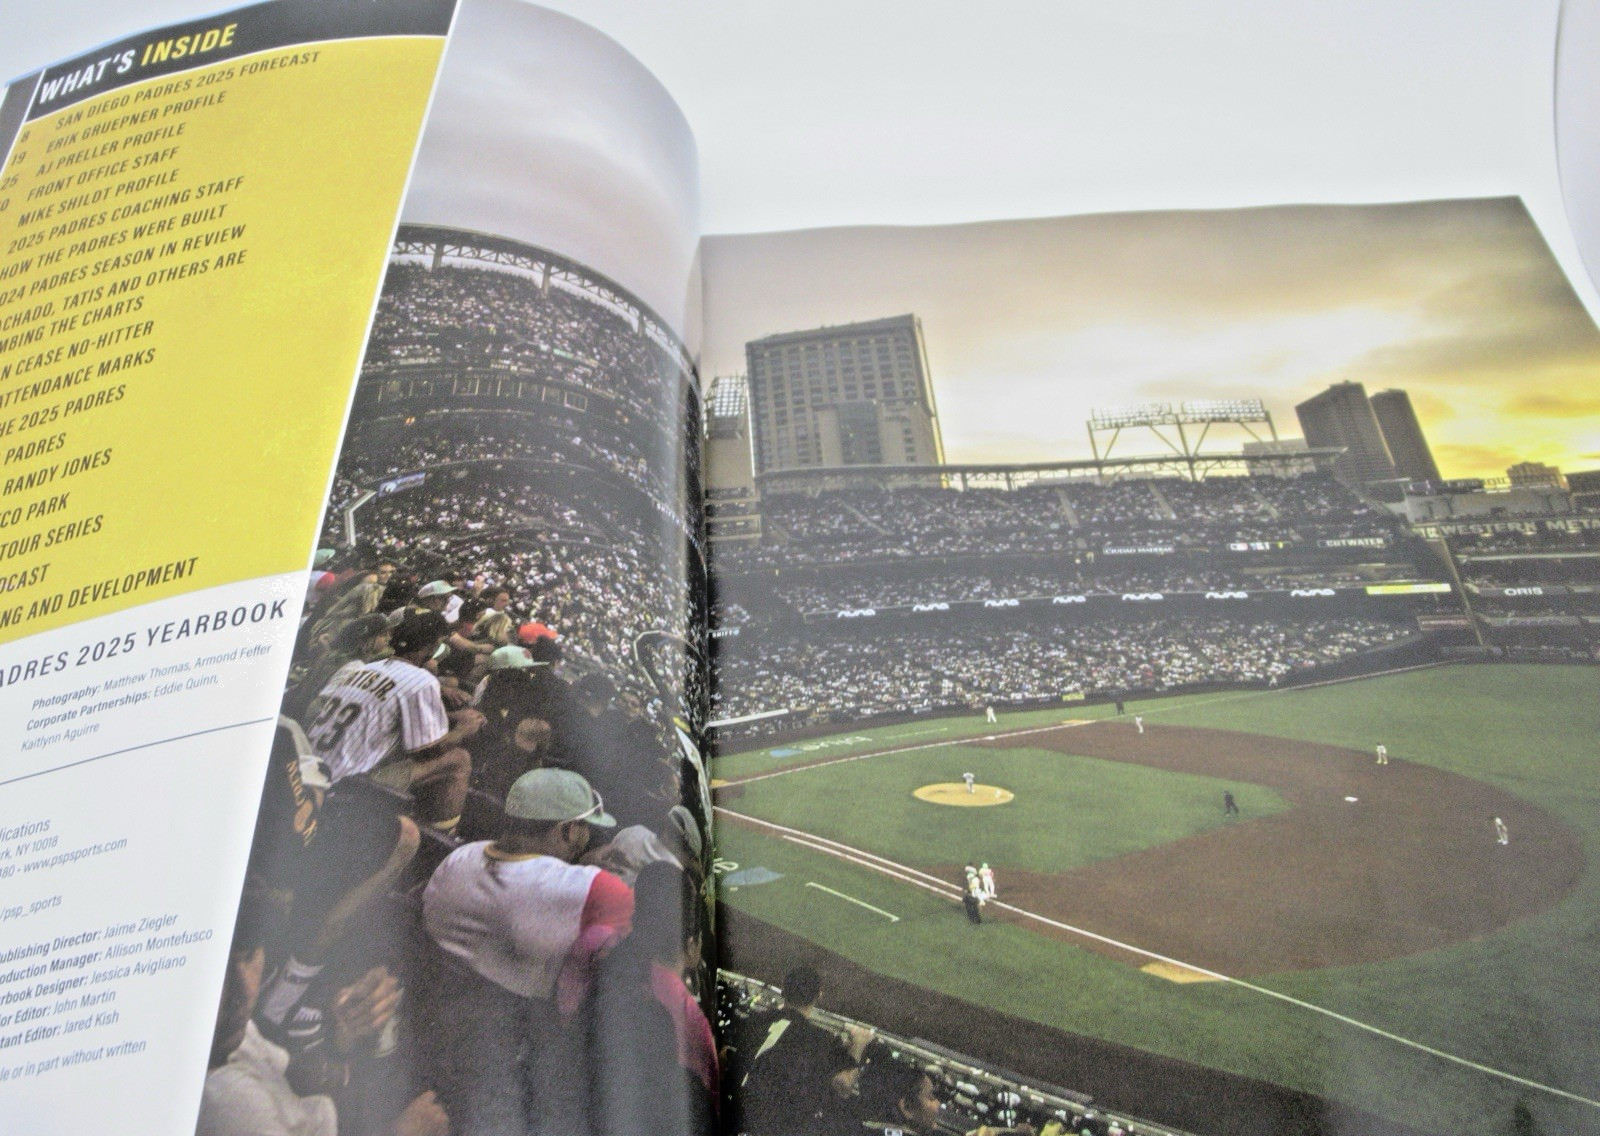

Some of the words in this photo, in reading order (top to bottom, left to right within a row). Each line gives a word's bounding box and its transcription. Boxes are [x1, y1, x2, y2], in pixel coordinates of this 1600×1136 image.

[39, 50, 136, 104] WHAT'S
[141, 23, 238, 67] INSIDE
[56, 110, 84, 130] SAN
[87, 95, 130, 118] DIEGO
[134, 79, 192, 104] PADRES
[196, 70, 235, 88] 2025
[239, 51, 321, 77] FORECAST
[11, 151, 27, 166] 19
[46, 132, 79, 154] ERIK
[81, 108, 159, 140] GRUEPNER
[163, 91, 228, 117] PROFILE
[0, 173, 20, 191] 25
[56, 140, 119, 170] PRELLER
[122, 122, 187, 150] PROFILE
[27, 175, 74, 201] FRONT
[77, 159, 129, 185] OFFICE
[132, 146, 180, 170] STAFF
[7, 230, 45, 255] 2025
[48, 211, 107, 241] PADRES
[111, 189, 191, 221] COACHING
[195, 175, 245, 199] STAFF
[17, 204, 55, 228] MIKE
[115, 168, 180, 198] PROFILE
[0, 258, 34, 280] HOW
[37, 248, 65, 268] THE
[68, 229, 128, 259] PADRES
[132, 216, 177, 240] WERE
[180, 204, 228, 228] BUILT
[30, 265, 88, 296] PADRES
[91, 247, 155, 276] SEASON
[159, 241, 178, 258] IN
[182, 224, 247, 252] REVIEW
[62, 286, 104, 311] TATIS
[107, 276, 141, 297] AND
[146, 259, 210, 287] OTHERS
[213, 249, 248, 271] ARE
[50, 315, 79, 337] THE
[82, 296, 145, 327] CHARTS
[15, 347, 65, 376] CEASE
[67, 320, 155, 359] NO-HITTER
[97, 348, 156, 378] MARKS
[18, 405, 60, 432] 2025
[63, 384, 127, 417] PADRES
[3, 465, 59, 496] RANDY
[61, 448, 113, 478] JONES
[4, 432, 67, 466] PADRES
[26, 492, 70, 521] PARK
[0, 533, 42, 562] TOUR
[44, 514, 104, 547] SERIES
[27, 594, 63, 620] AND
[67, 557, 198, 609] DEVELOPMENT
[76, 632, 137, 667] 2025
[147, 599, 288, 647] YEARBOOK
[32, 684, 102, 711] Photography:
[104, 671, 147, 691] Matthew
[149, 661, 192, 680] Thomas,
[194, 652, 237, 669] Armond
[240, 644, 272, 659] Feffer
[26, 710, 78, 731] Corporate
[79, 690, 151, 718] Partnerships:
[154, 681, 184, 698] Eddie
[185, 673, 219, 690] Quinn,
[21, 732, 62, 751] Kaitlynn
[63, 722, 100, 742] Aguirre
[16, 843, 31, 857] NY
[33, 835, 59, 853] 10018
[23, 838, 128, 873] www.pspsports.com
[50, 951, 103, 973] Manager:
[104, 942, 143, 960] Allison
[145, 928, 213, 951] Montefusco
[52, 929, 101, 952] Director:
[104, 921, 136, 940] Jaime
[137, 913, 179, 933] Ziegler
[34, 975, 89, 998] Designer:
[91, 965, 130, 985] Jessica
[132, 954, 187, 976] Avigliano
[14, 1005, 51, 1025] Editor:
[53, 998, 78, 1015] John
[80, 988, 116, 1008] Martin
[24, 1025, 62, 1044] Editor:
[63, 1014, 93, 1035] Jared
[94, 1009, 120, 1028] Kish
[11, 1065, 24, 1078] or
[25, 1060, 36, 1076] in
[36, 1056, 60, 1077] part
[62, 1047, 104, 1067] without
[106, 1040, 147, 1058] written
